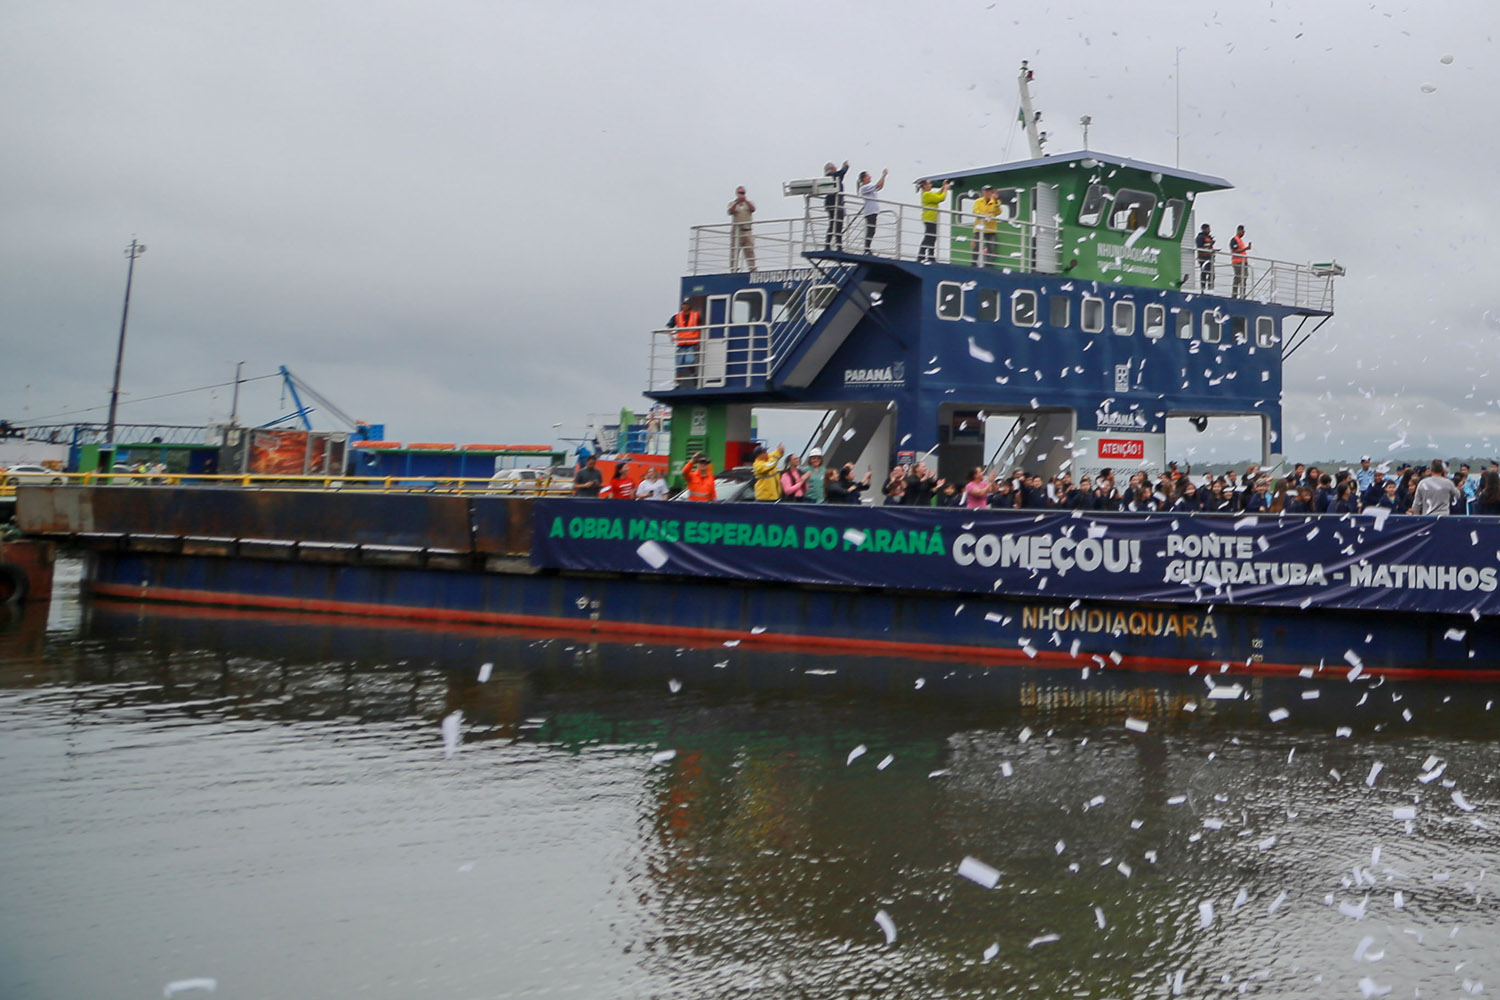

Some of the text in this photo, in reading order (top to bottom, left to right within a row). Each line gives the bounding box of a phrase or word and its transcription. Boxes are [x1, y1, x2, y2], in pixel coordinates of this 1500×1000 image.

[844, 366, 893, 382] PARANÁ
[1102, 441, 1142, 458] ATENÇÃO!
[549, 517, 564, 539] A
[568, 517, 624, 540] OBRA
[628, 518, 680, 543] MAIS
[684, 521, 799, 549] ESPERADA
[803, 526, 838, 551] DO
[1167, 535, 1253, 559] PONTE
[952, 533, 1141, 577] COMEÇOU!
[1168, 560, 1328, 586] GUARATUBA
[1350, 564, 1498, 592] MATINHOS
